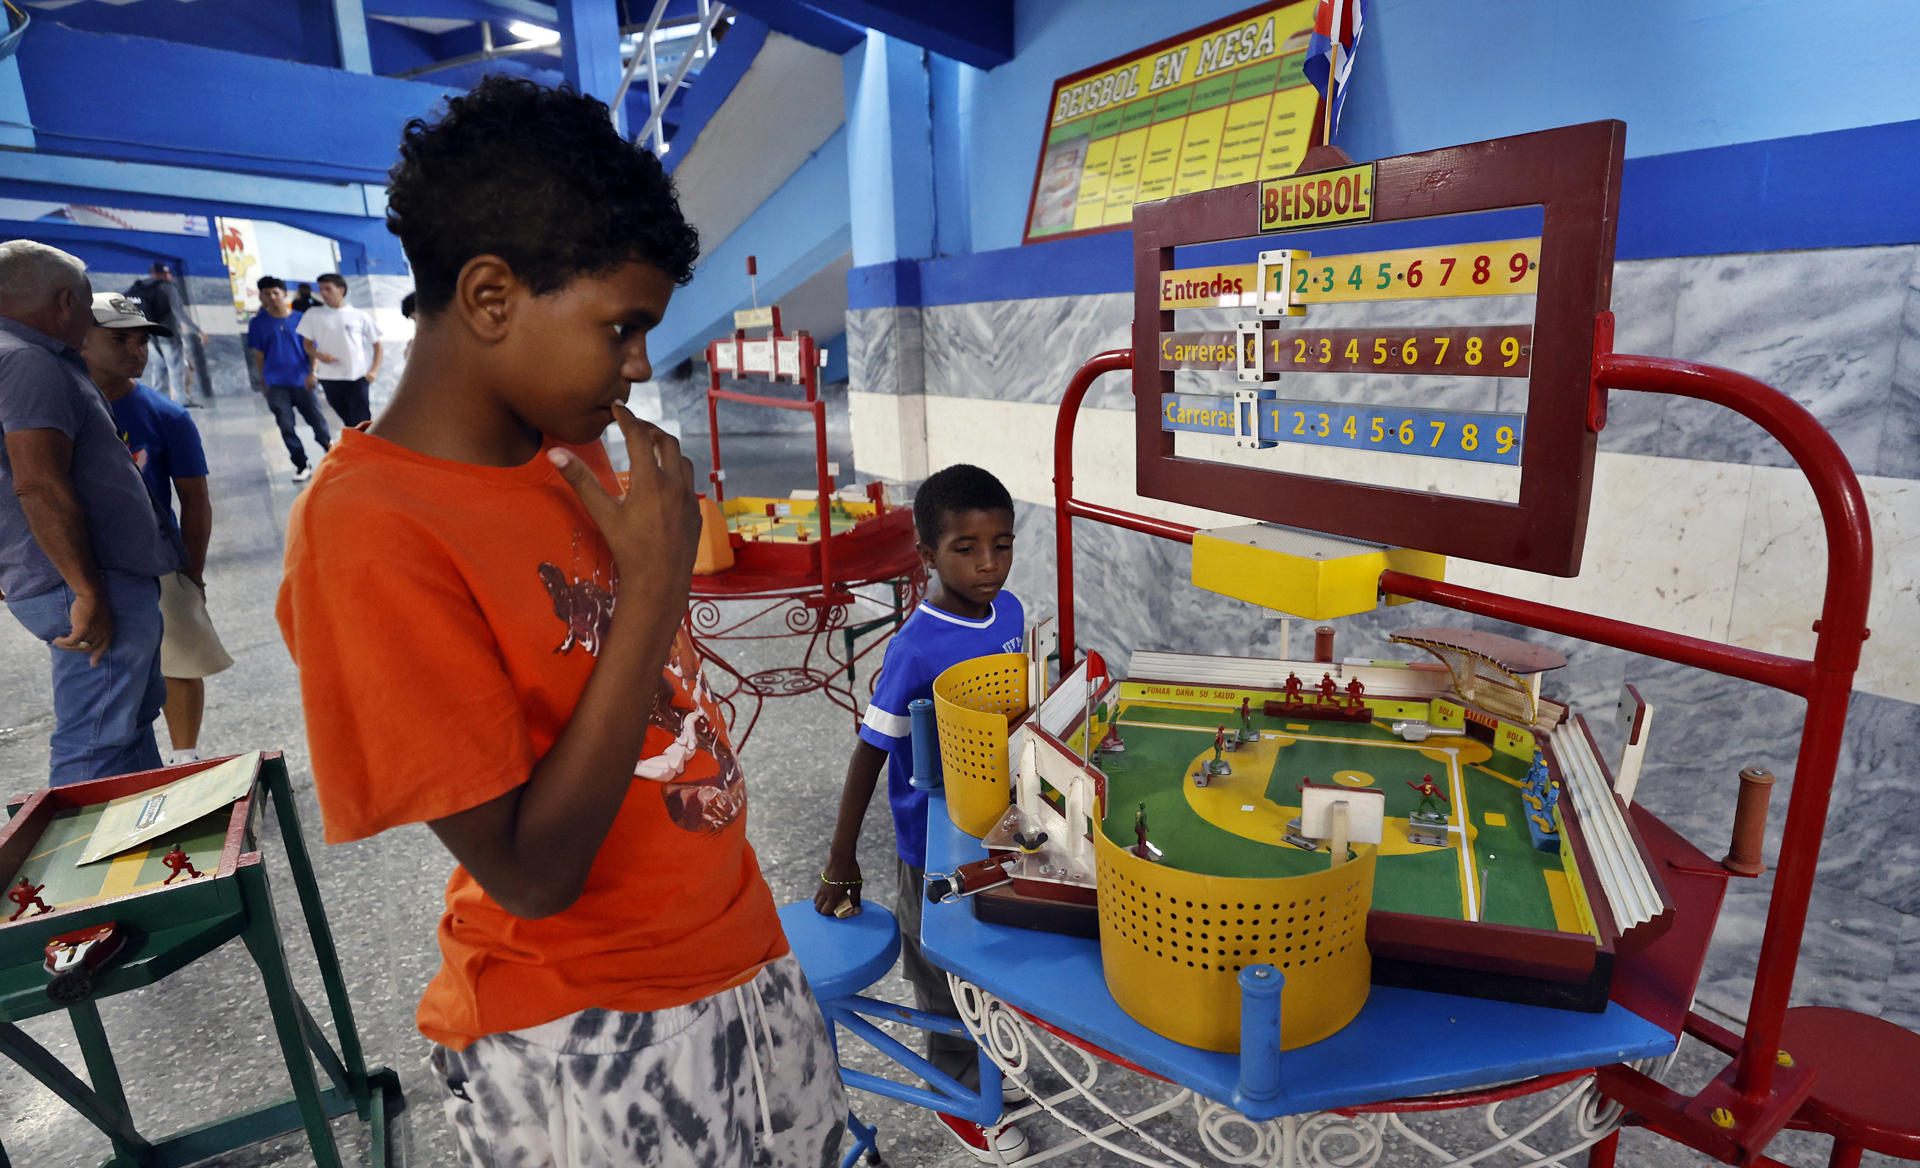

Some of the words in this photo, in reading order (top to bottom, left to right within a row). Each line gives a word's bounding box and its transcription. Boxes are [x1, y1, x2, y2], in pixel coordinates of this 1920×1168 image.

[1054, 64, 1140, 122] BEISBOL
[1149, 48, 1188, 92] EN
[1194, 17, 1275, 77] MESA
[1265, 174, 1366, 224] BEISBOL
[1163, 273, 1242, 301] Entradas
[1273, 271, 1282, 293] 1
[1296, 269, 1308, 293] 2
[1321, 267, 1334, 292] 3
[1348, 265, 1362, 290] 4
[1376, 263, 1391, 290] 5
[1406, 260, 1423, 288] 6
[1439, 258, 1456, 286] 7
[1472, 255, 1491, 285] 8
[1509, 252, 1529, 284] 9
[1162, 337, 1236, 362] Carreras
[1271, 339, 1280, 363] 1
[1294, 339, 1307, 363] 2
[1319, 338, 1332, 363] 3
[1344, 338, 1359, 364] 4
[1373, 338, 1387, 365] 5
[1402, 337, 1418, 365] 6
[1434, 337, 1450, 365] 7
[1464, 336, 1483, 366] 8
[1500, 336, 1520, 368] 9
[1166, 401, 1235, 428] Carreras
[1271, 410, 1279, 433] 1
[1293, 411, 1305, 435] 2
[1317, 413, 1330, 437] 3
[1342, 415, 1357, 439] 4
[1370, 417, 1384, 442] 5
[1399, 419, 1414, 445] 6
[1429, 421, 1446, 447] 7
[1461, 423, 1478, 451] 8
[1495, 426, 1514, 454] 9
[1147, 686, 1170, 695] FUMAR
[1176, 687, 1194, 697] DAÑA
[1199, 690, 1208, 698] SU
[1213, 690, 1235, 700] SALUD
[1438, 706, 1454, 718] BOLA
[1467, 711, 1493, 727] STRIKE
[1506, 730, 1524, 743] BOLA
[1424, 784, 1432, 794] 5
